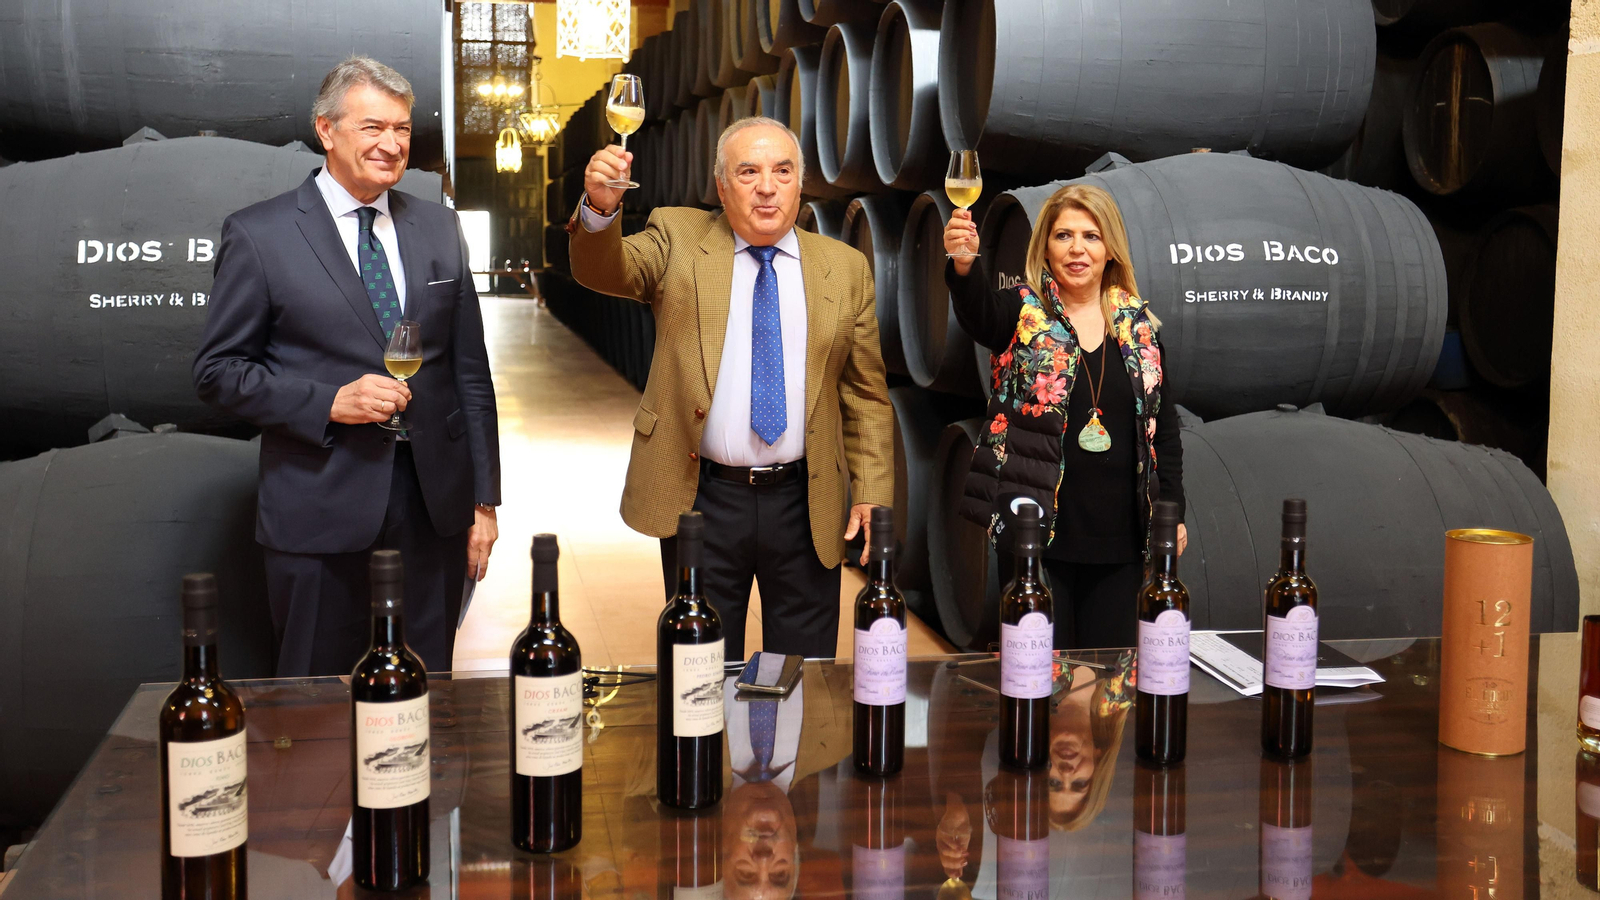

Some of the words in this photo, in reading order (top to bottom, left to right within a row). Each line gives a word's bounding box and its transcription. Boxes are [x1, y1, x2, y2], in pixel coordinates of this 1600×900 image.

[77, 239, 162, 264] DIOS
[187, 238, 214, 262] B
[1169, 243, 1245, 264] DIOS
[1263, 240, 1339, 266] BACO
[89, 293, 164, 309] SHERRY
[169, 292, 183, 307] &
[1185, 290, 1249, 303] SHERRY
[1252, 288, 1264, 301] &
[1270, 287, 1328, 302] BRANDY
[1474, 600, 1512, 627] 12
[1143, 636, 1165, 647] DIOS
[1168, 634, 1190, 647] BAC
[1272, 631, 1295, 642] DIOS
[1298, 630, 1318, 642] BAC
[858, 645, 879, 656] DIOS
[1006, 639, 1028, 650] DIOS
[683, 655, 708, 666] DIOS
[524, 689, 551, 700] DIOS
[365, 716, 394, 727] DIOS
[180, 755, 213, 768] DIOS
